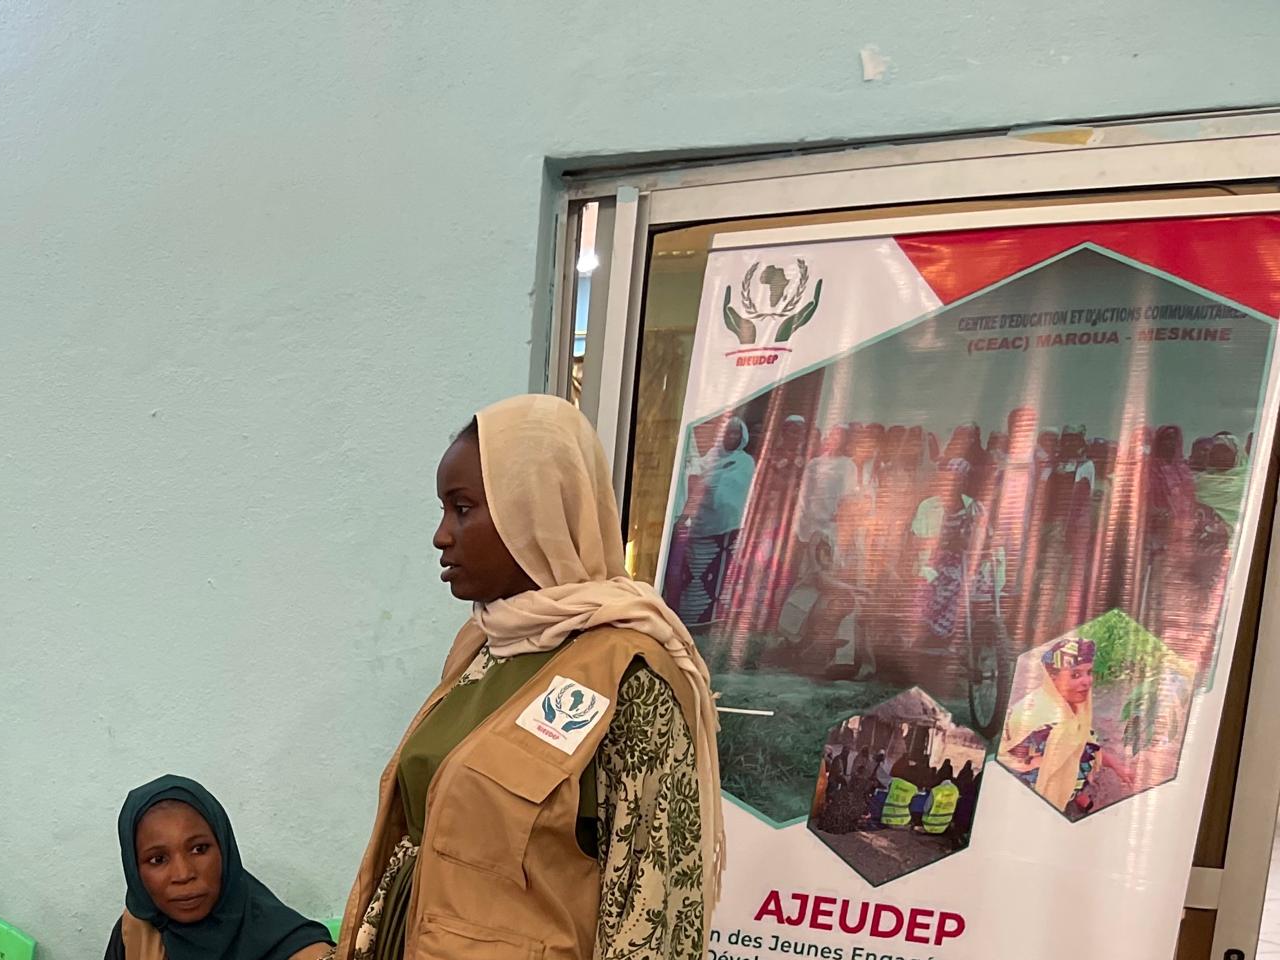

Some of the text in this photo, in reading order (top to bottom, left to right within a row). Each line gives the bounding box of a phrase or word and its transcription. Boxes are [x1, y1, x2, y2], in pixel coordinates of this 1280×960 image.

[958, 314, 997, 332] CENTRE
[968, 327, 1233, 353] (CEAC) MAROUA MESKINE
[754, 890, 965, 946] AJEUDEP
[728, 929, 762, 949] des
[769, 935, 843, 960] Jeunes
